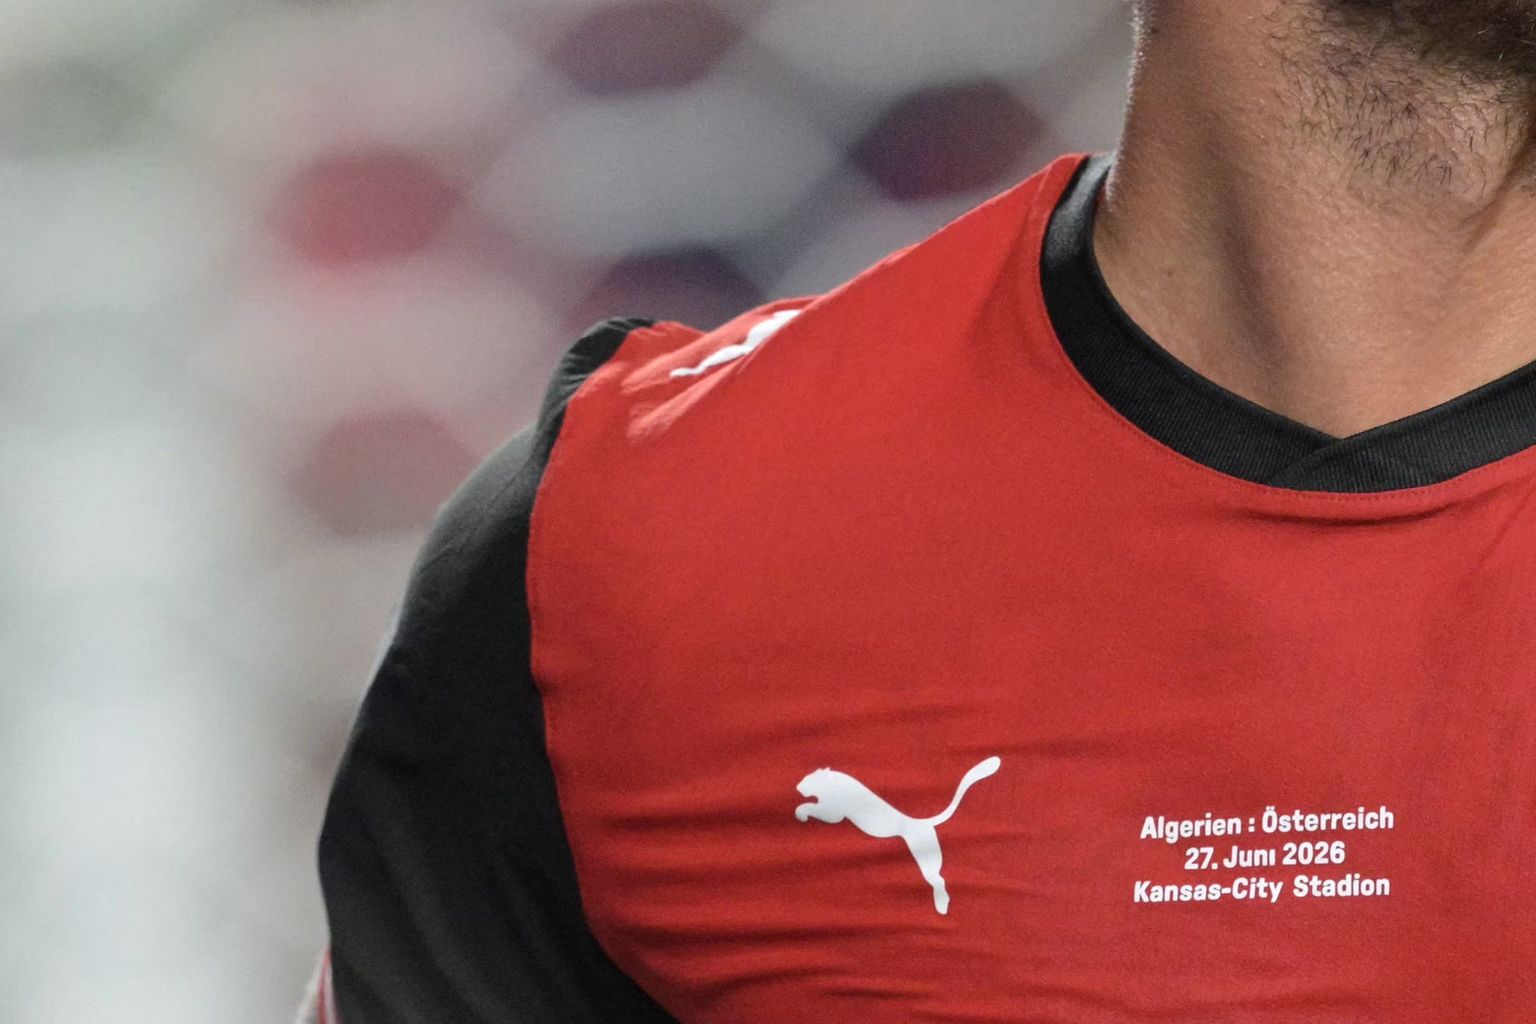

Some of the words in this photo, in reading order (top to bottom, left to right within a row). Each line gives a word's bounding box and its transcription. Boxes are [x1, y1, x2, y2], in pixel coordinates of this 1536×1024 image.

[1140, 813, 1242, 844] Algerien
[1261, 806, 1394, 833] Österreich
[1184, 847, 1218, 870] 27.
[1223, 845, 1276, 868] Juni
[1282, 841, 1346, 865] 2026
[1134, 877, 1283, 903] Kansas-City
[1293, 873, 1390, 897] Stadion
